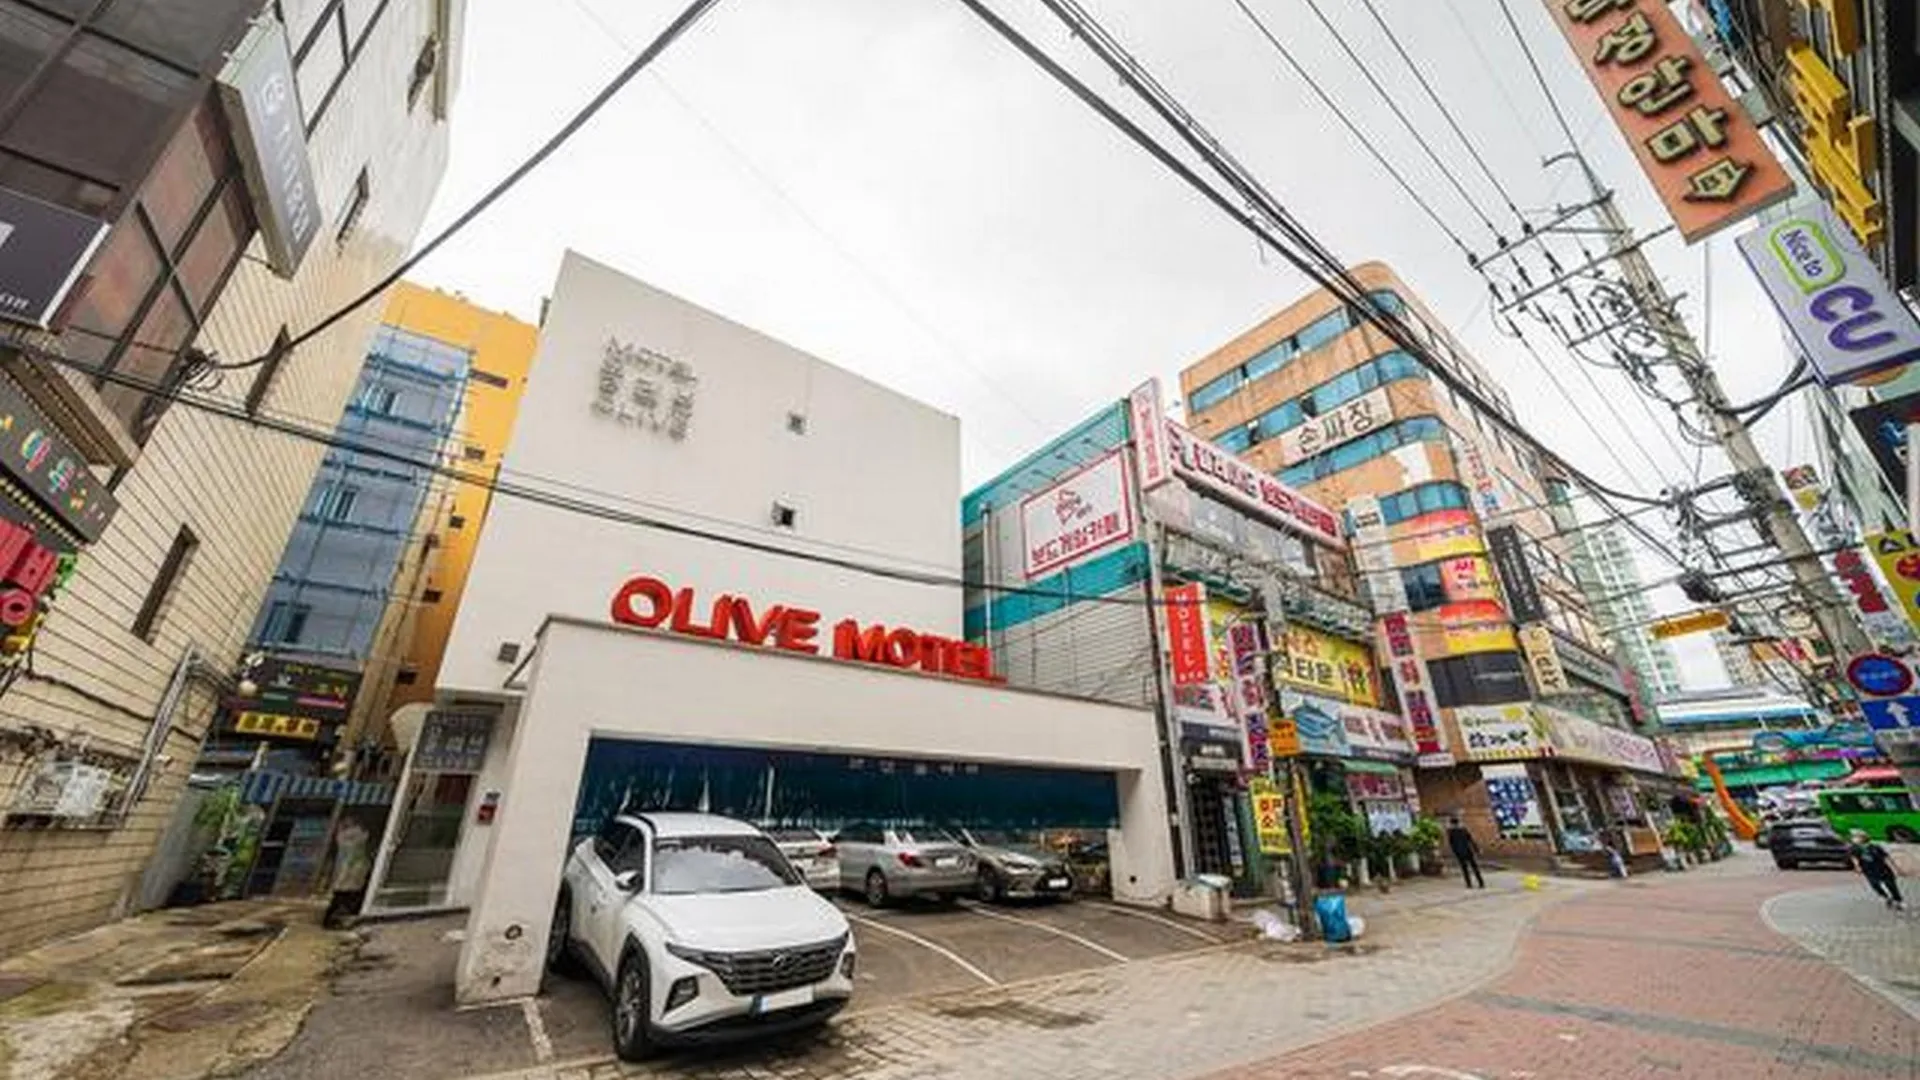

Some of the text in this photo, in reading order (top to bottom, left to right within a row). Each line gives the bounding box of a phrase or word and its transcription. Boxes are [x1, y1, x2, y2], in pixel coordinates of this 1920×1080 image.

[1781, 229, 1823, 277] Nice to
[1810, 286, 1897, 352] CU
[1299, 399, 1373, 454] 손짜장
[611, 576, 1007, 685] OLIVE MOTEL
[1175, 592, 1196, 667] MOTEL
